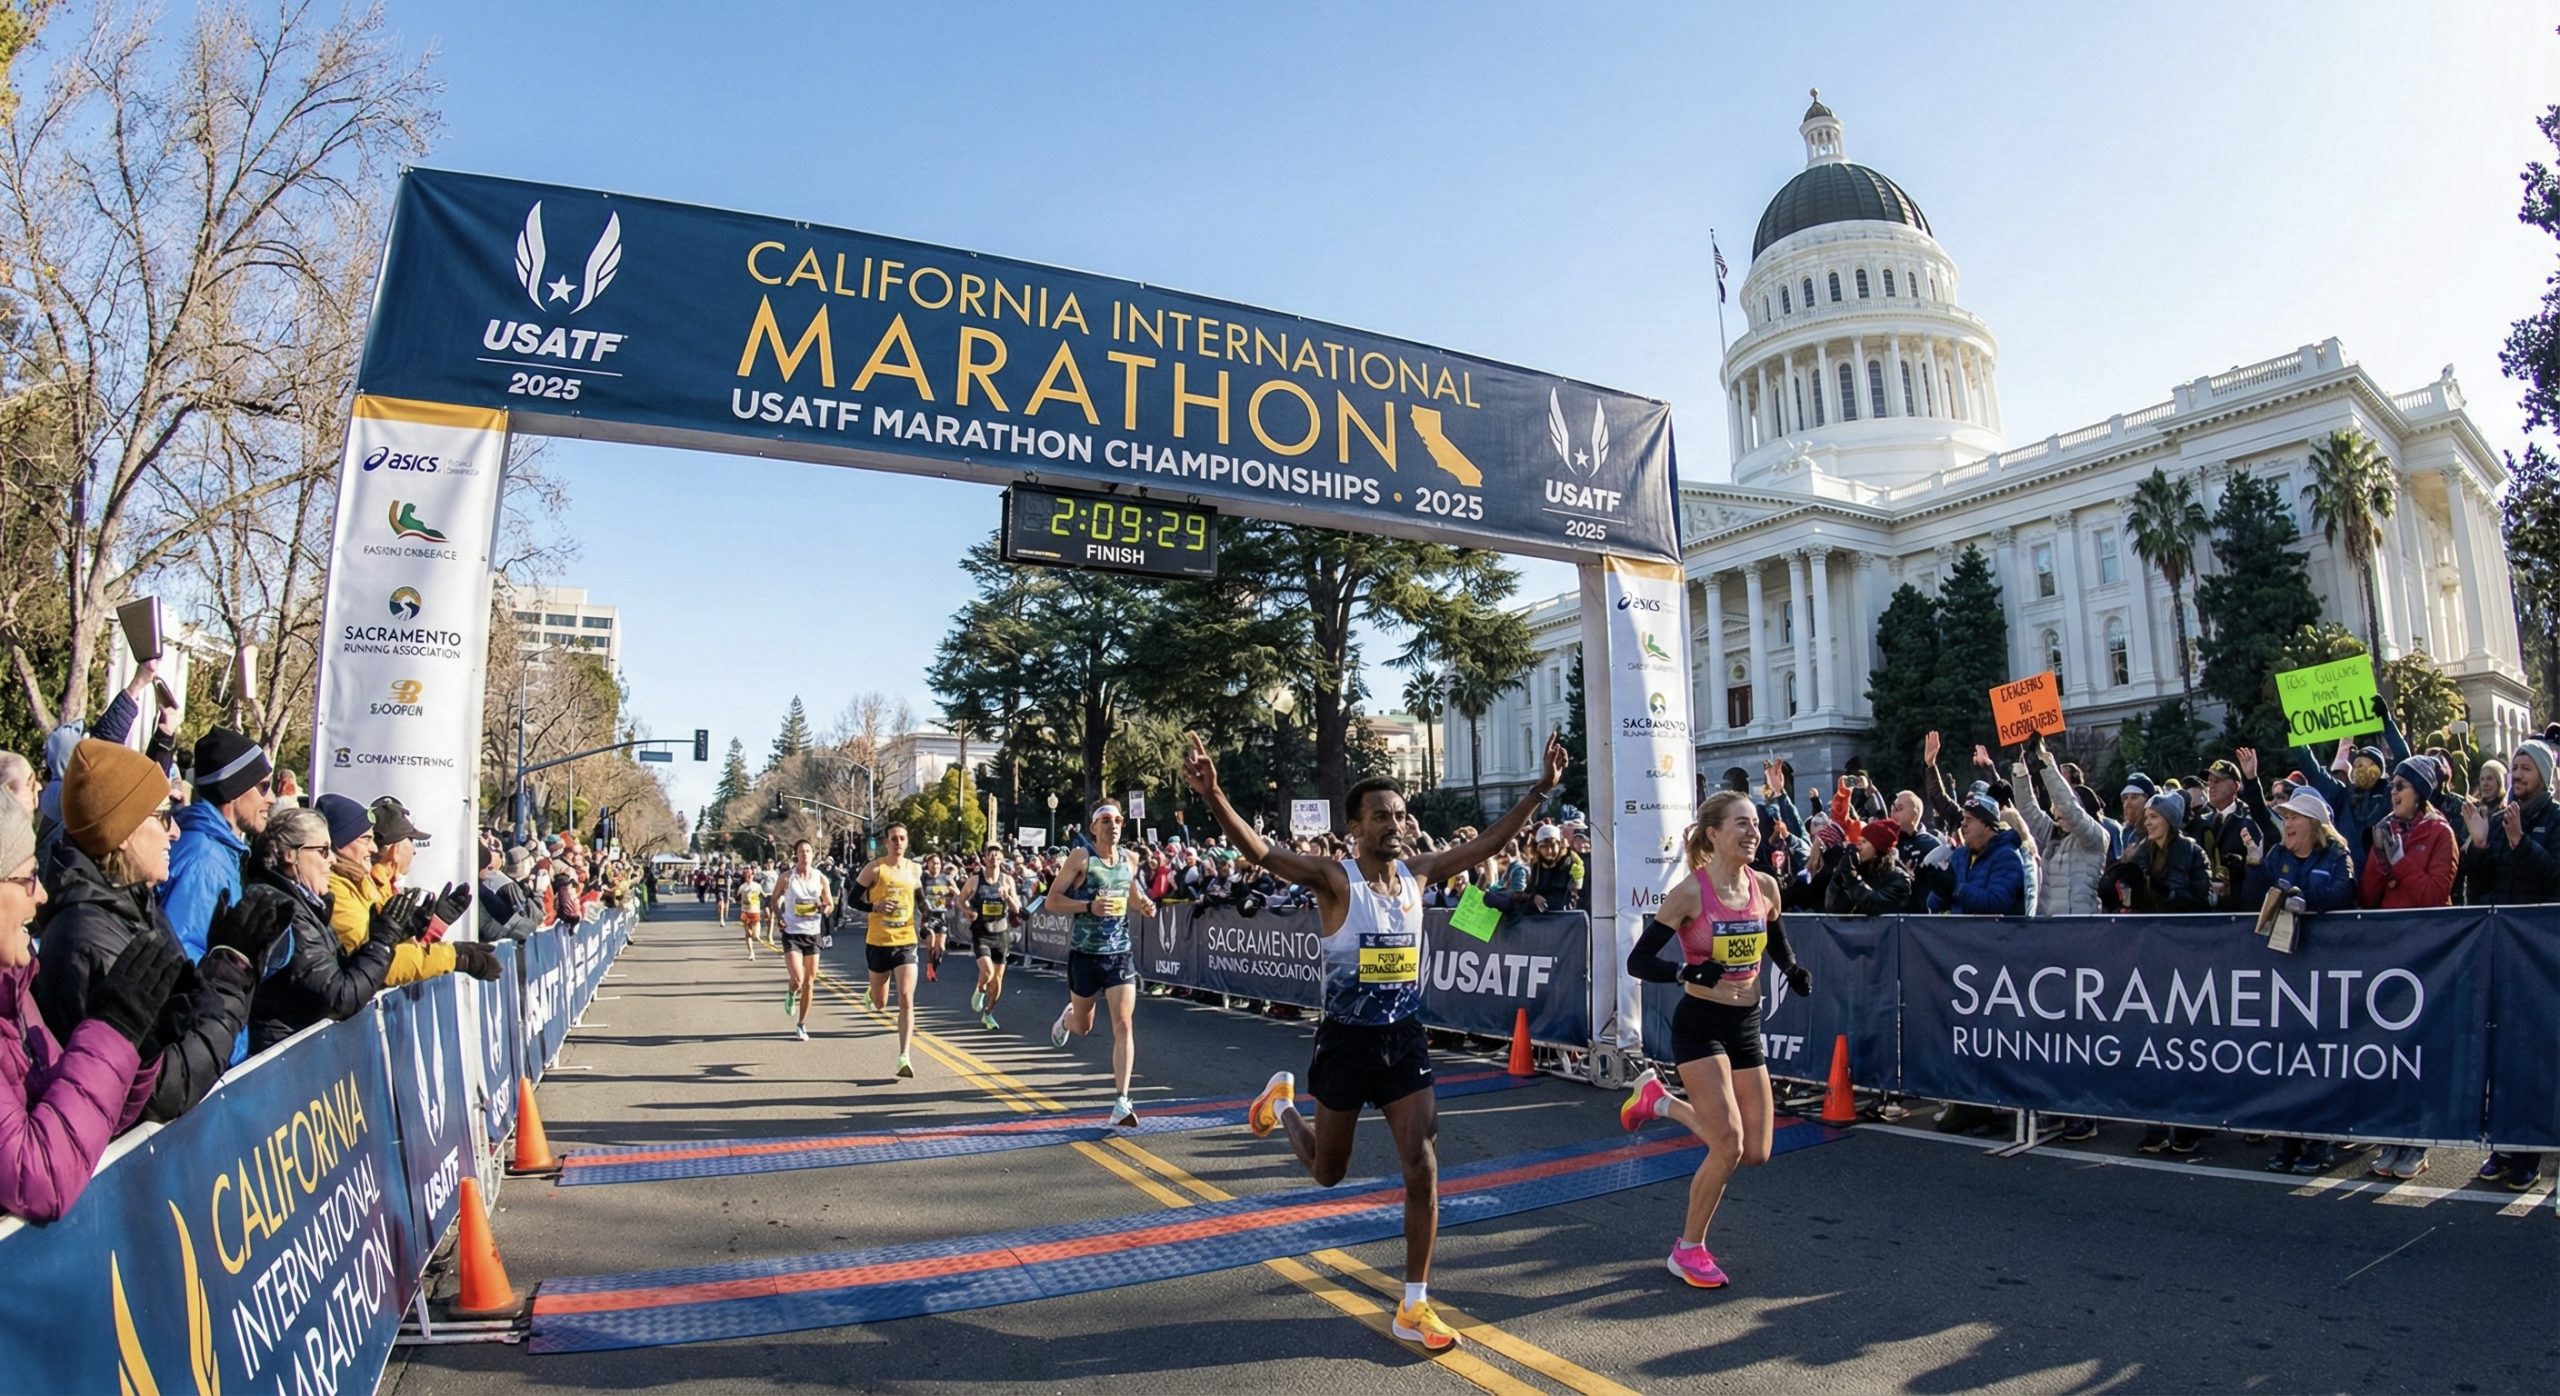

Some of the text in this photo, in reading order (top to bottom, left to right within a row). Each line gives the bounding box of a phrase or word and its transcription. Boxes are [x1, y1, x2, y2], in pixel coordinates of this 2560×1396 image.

[482, 317, 623, 362] USATF
[747, 240, 1482, 409] CALIFORNIA INTERNATIONAL
[508, 372, 582, 400] 2025
[736, 293, 1398, 472] MARATHON
[731, 388, 1485, 521] USATF MARATHON CHAMPIONSHIPS 2025
[1545, 478, 1622, 513] USATF
[1051, 497, 1206, 551] 2:09:29
[1565, 519, 1608, 540] 2025
[1086, 544, 1145, 565] FINISH
[343, 643, 461, 659] RUNNING ASSOCIATION
[344, 626, 462, 646] SACRAMENTO
[2291, 695, 2375, 736] COWBELL
[1208, 926, 1321, 960] SACRAMENTO
[1433, 949, 1553, 998] USATF
[1951, 964, 2425, 1031] SACRAMENTO
[1952, 1026, 2422, 1081] RUNNING ASSOCIATION
[211, 1071, 368, 1275] CALIFORNIA
[424, 1146, 460, 1221] USATF
[232, 1153, 380, 1381] INTERNATIONAL
[275, 1213, 395, 1396] ARATHON
